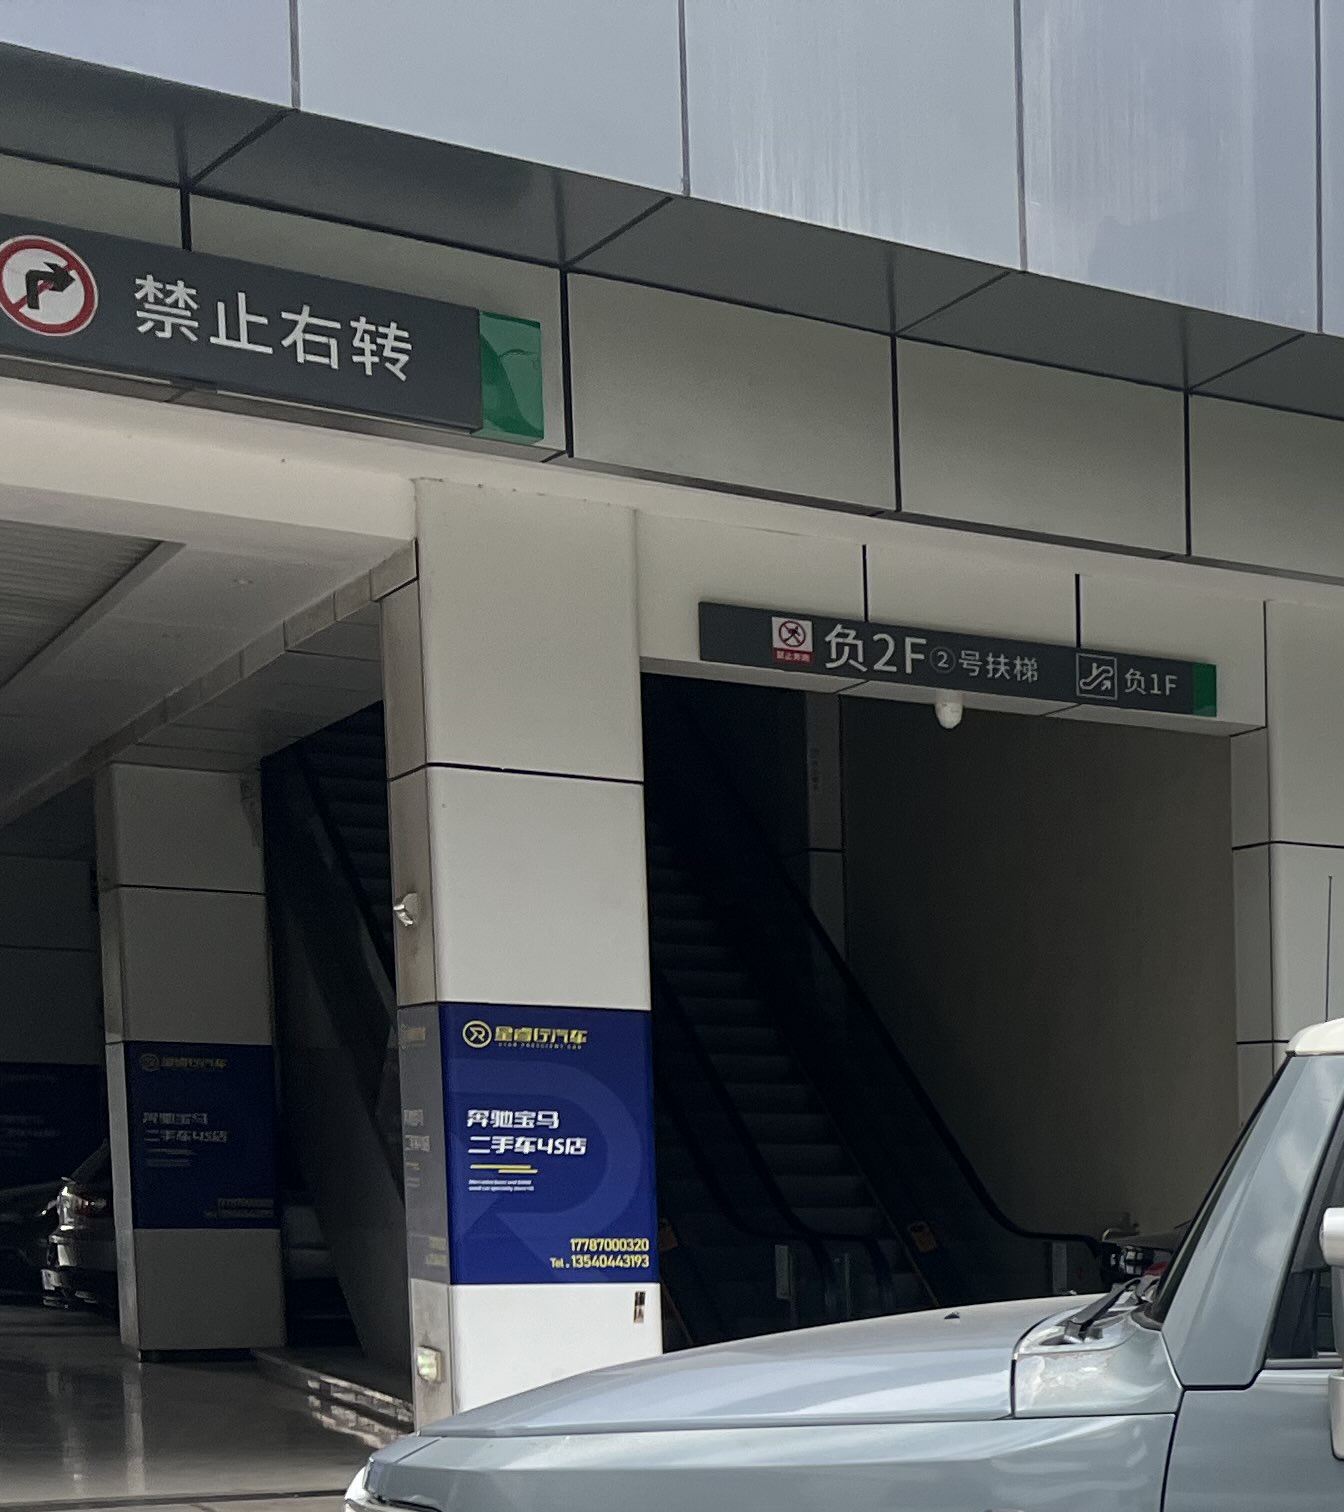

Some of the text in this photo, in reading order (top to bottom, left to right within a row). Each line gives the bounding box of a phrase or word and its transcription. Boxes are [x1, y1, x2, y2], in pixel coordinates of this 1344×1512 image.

[134, 274, 412, 382] 禁止右转
[824, 624, 928, 674] 负2F
[1124, 668, 1179, 697] 负1F
[467, 1109, 560, 1129] 奔驰宝马
[468, 1135, 587, 1155] 二手车4S店
[570, 1238, 650, 1252] 17787000320
